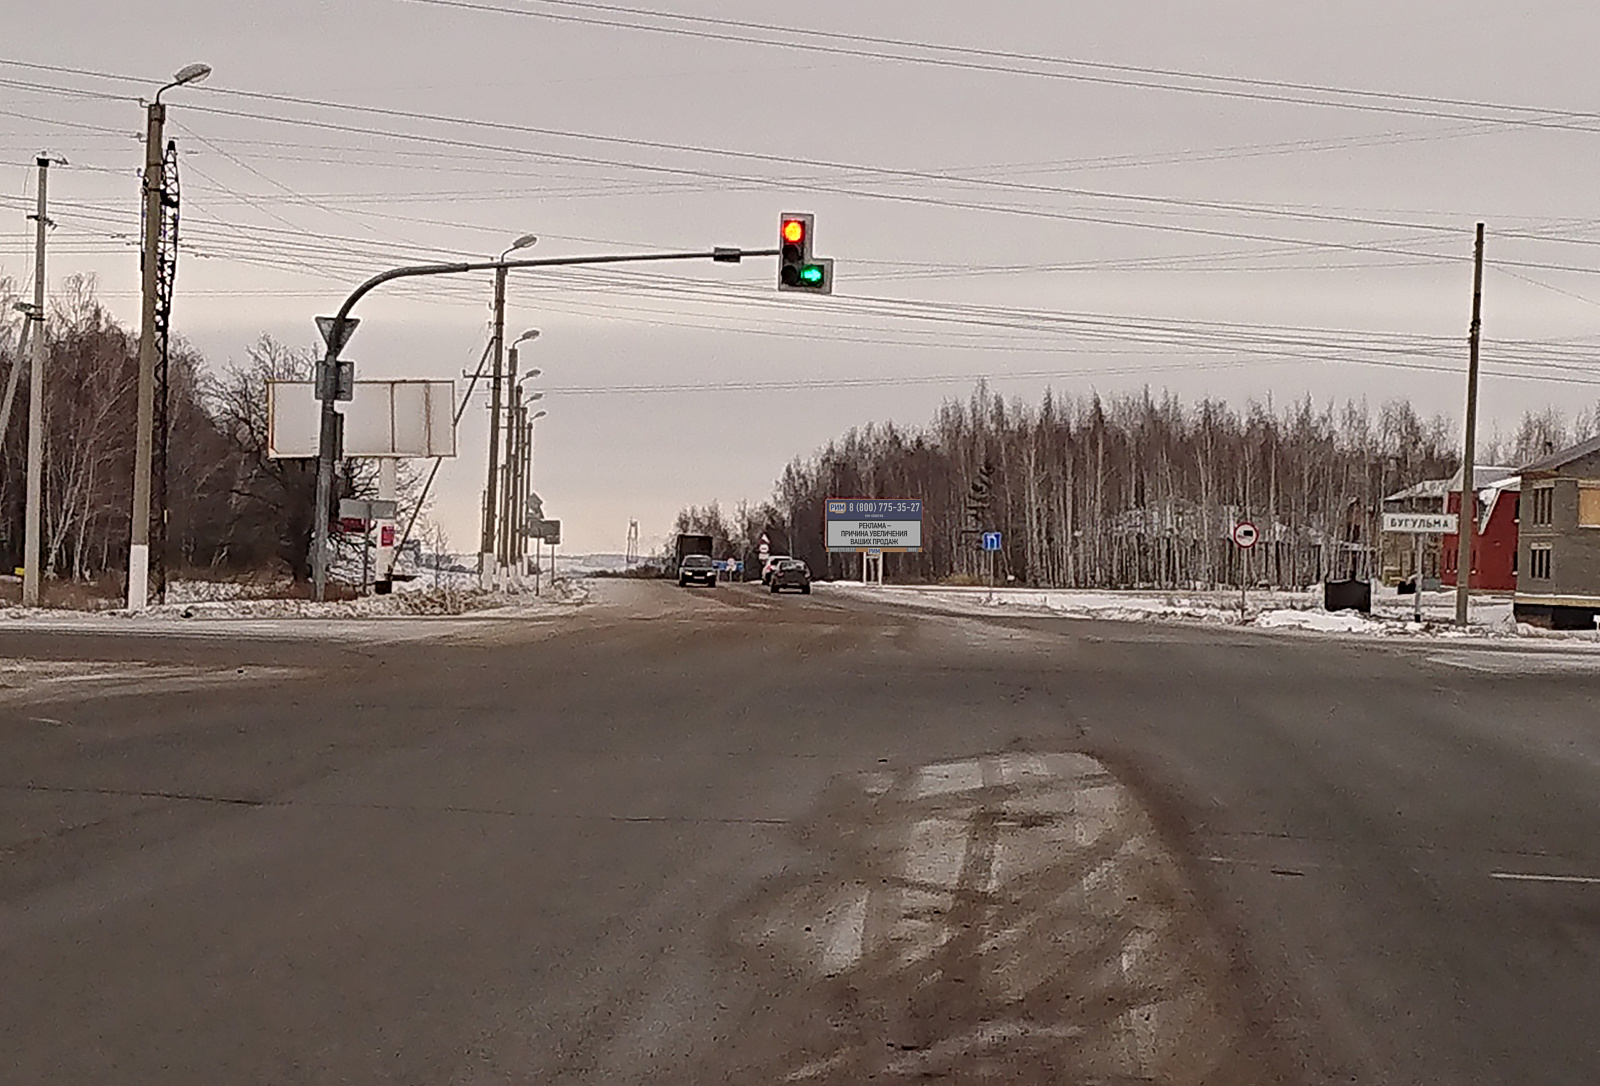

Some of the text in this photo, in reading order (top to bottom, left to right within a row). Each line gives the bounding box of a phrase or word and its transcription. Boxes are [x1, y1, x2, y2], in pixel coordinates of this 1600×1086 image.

[849, 502, 920, 513] 8 (800) 775-35-27
